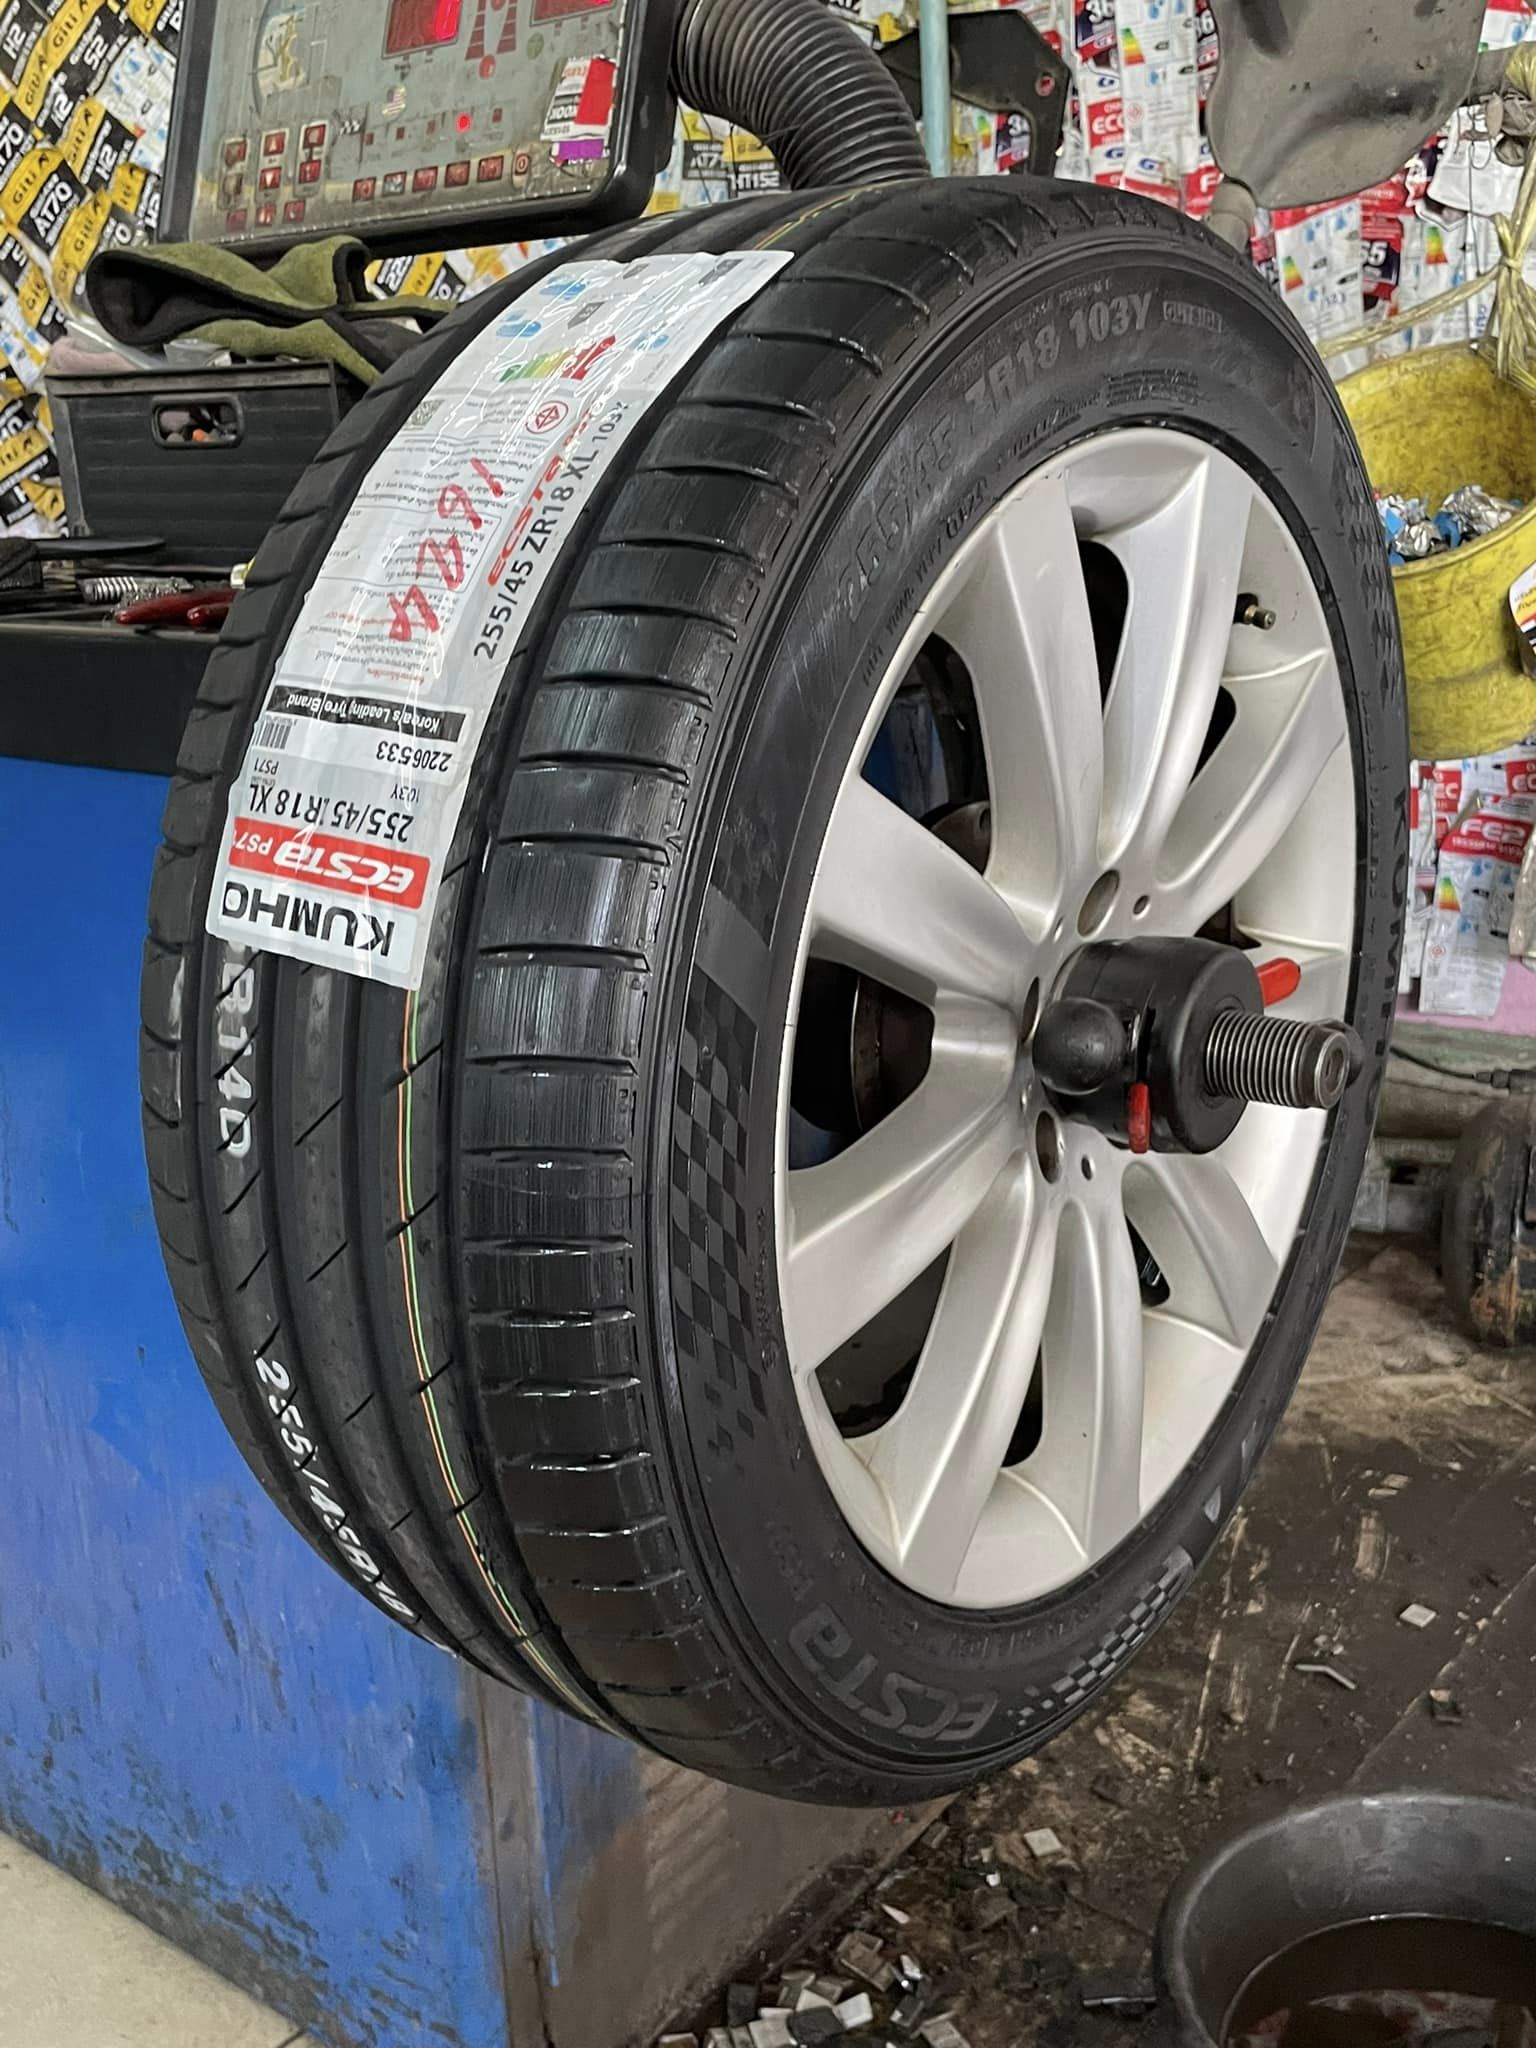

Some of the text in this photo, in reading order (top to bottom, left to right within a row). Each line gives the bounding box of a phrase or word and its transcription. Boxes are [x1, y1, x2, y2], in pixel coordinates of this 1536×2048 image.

[13, 171, 37, 205] Giti
[34, 181, 73, 238] AT70
[1069, 291, 1153, 350] 103Y
[474, 559, 534, 661] 255/45
[522, 485, 575, 554] ZR18
[565, 450, 598, 482] XL
[287, 693, 323, 713] Brand
[254, 757, 279, 775] PS71
[376, 740, 453, 772] 2206533
[248, 783, 274, 814] XL
[331, 800, 415, 843] 255/45
[272, 840, 415, 895] ECSTA
[221, 881, 396, 957] KUMHO
